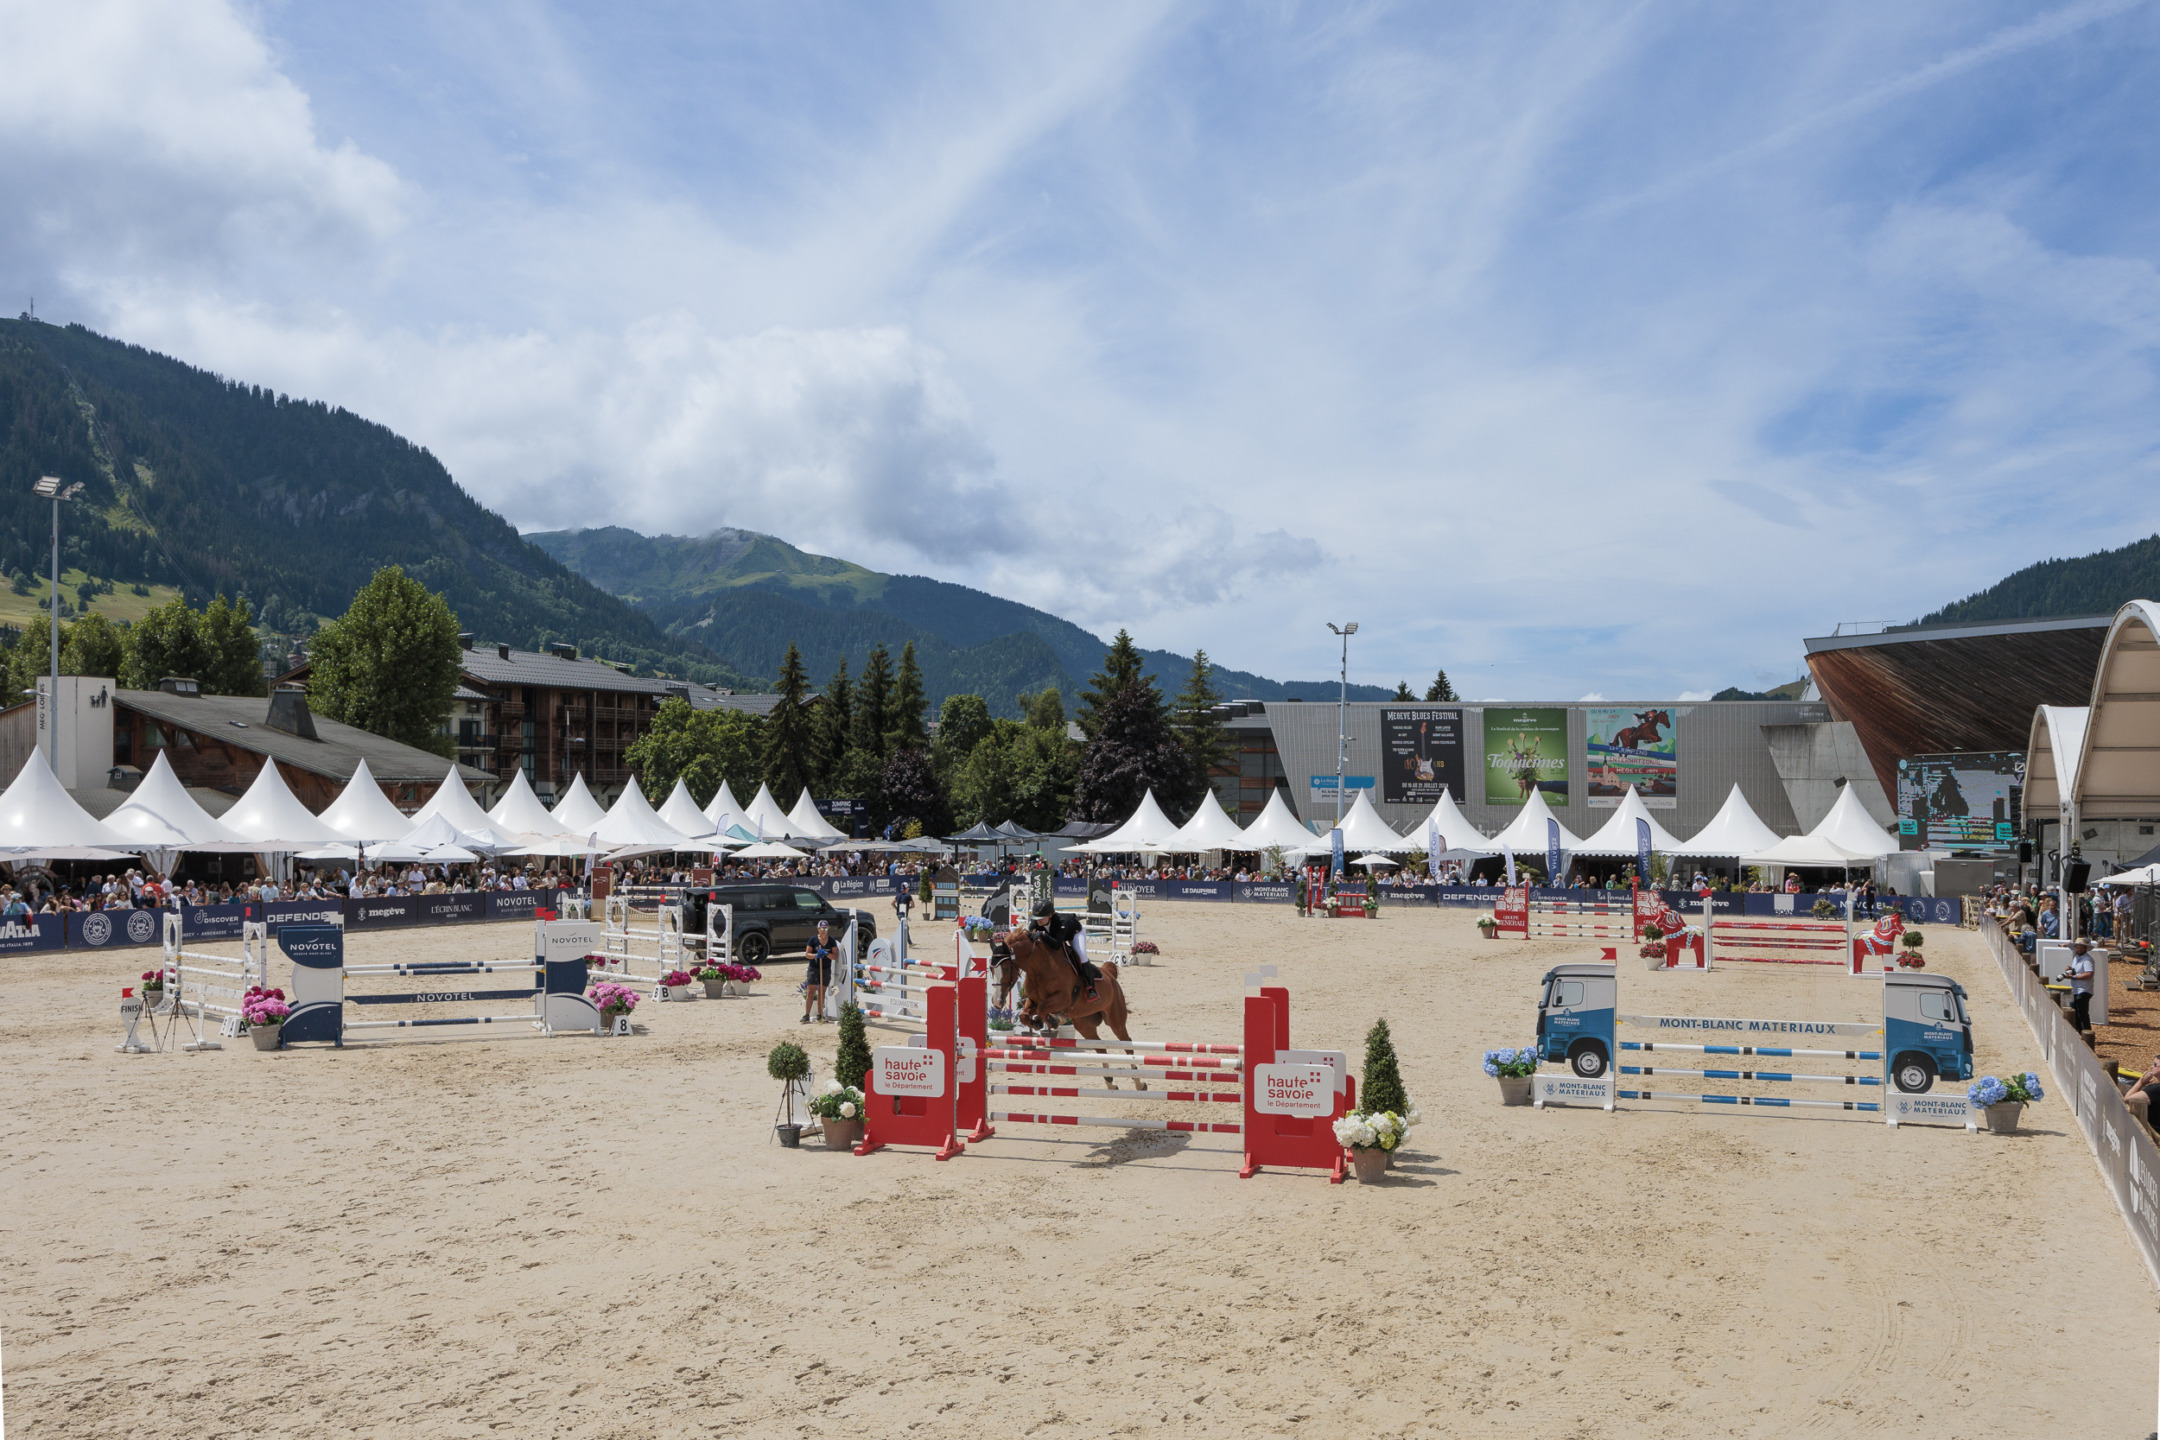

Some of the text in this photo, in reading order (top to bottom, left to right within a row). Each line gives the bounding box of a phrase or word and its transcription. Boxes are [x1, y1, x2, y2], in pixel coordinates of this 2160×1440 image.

[1412, 712, 1430, 720] BLUES
[1431, 712, 1458, 720] FESTIVAL
[1487, 752, 1565, 774] Toquicimes
[846, 880, 864, 889] Région
[496, 896, 537, 906] NOVOTEL
[368, 907, 406, 917] megève
[204, 916, 238, 924] DISCOVER
[267, 912, 328, 923] DEFENDE
[417, 992, 475, 1002] NOVOTEL
[662, 987, 669, 998] B
[238, 1021, 247, 1033] A
[620, 1019, 627, 1031] 8
[1660, 1018, 1836, 1034] MONT-BLANC MATERIAUX
[885, 1057, 922, 1070] haute
[886, 1070, 927, 1081] savoie
[892, 1082, 933, 1090] Département
[1267, 1074, 1308, 1088] haute
[1559, 1082, 1606, 1090] MONT-BLANC
[1268, 1089, 1314, 1100] savoie
[1558, 1089, 1606, 1097] MATERIAUX
[1914, 1100, 1966, 1108] MONT-BLANC
